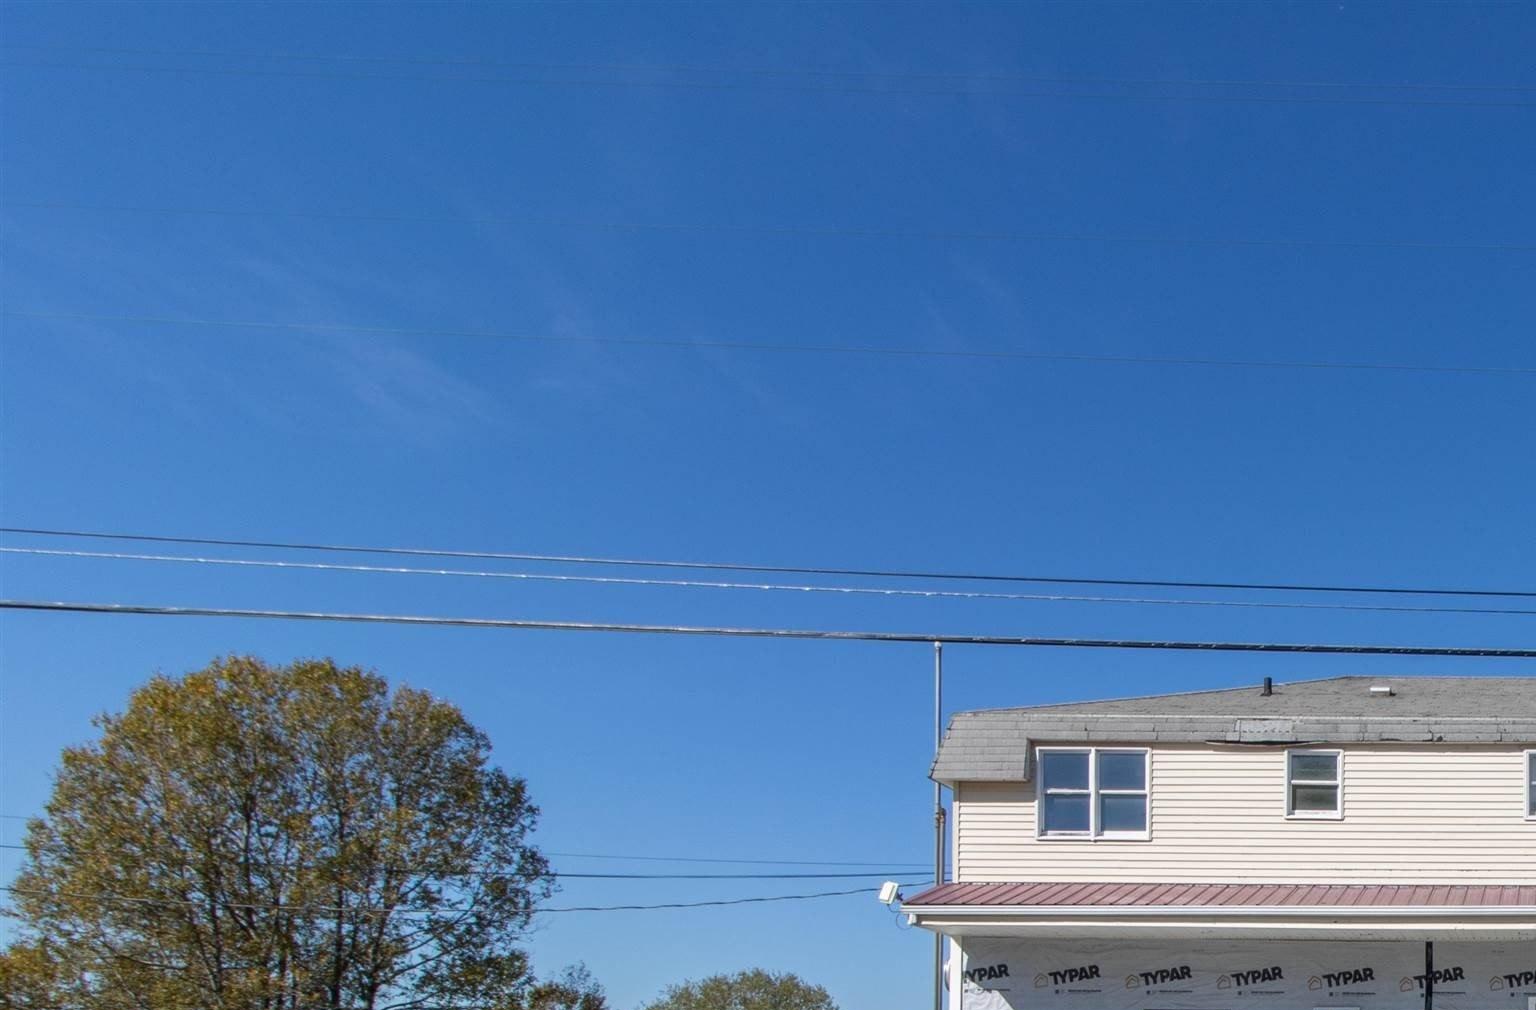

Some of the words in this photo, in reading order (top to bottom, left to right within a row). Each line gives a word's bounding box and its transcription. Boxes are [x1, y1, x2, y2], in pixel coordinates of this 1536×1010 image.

[964, 964, 1010, 983] YPAR
[1048, 965, 1101, 985] TYPAR
[1139, 966, 1192, 986] TYPAR
[1231, 966, 1284, 987] TYPAR
[1322, 967, 1375, 988] TYPAR
[1413, 967, 1464, 989] TPAR
